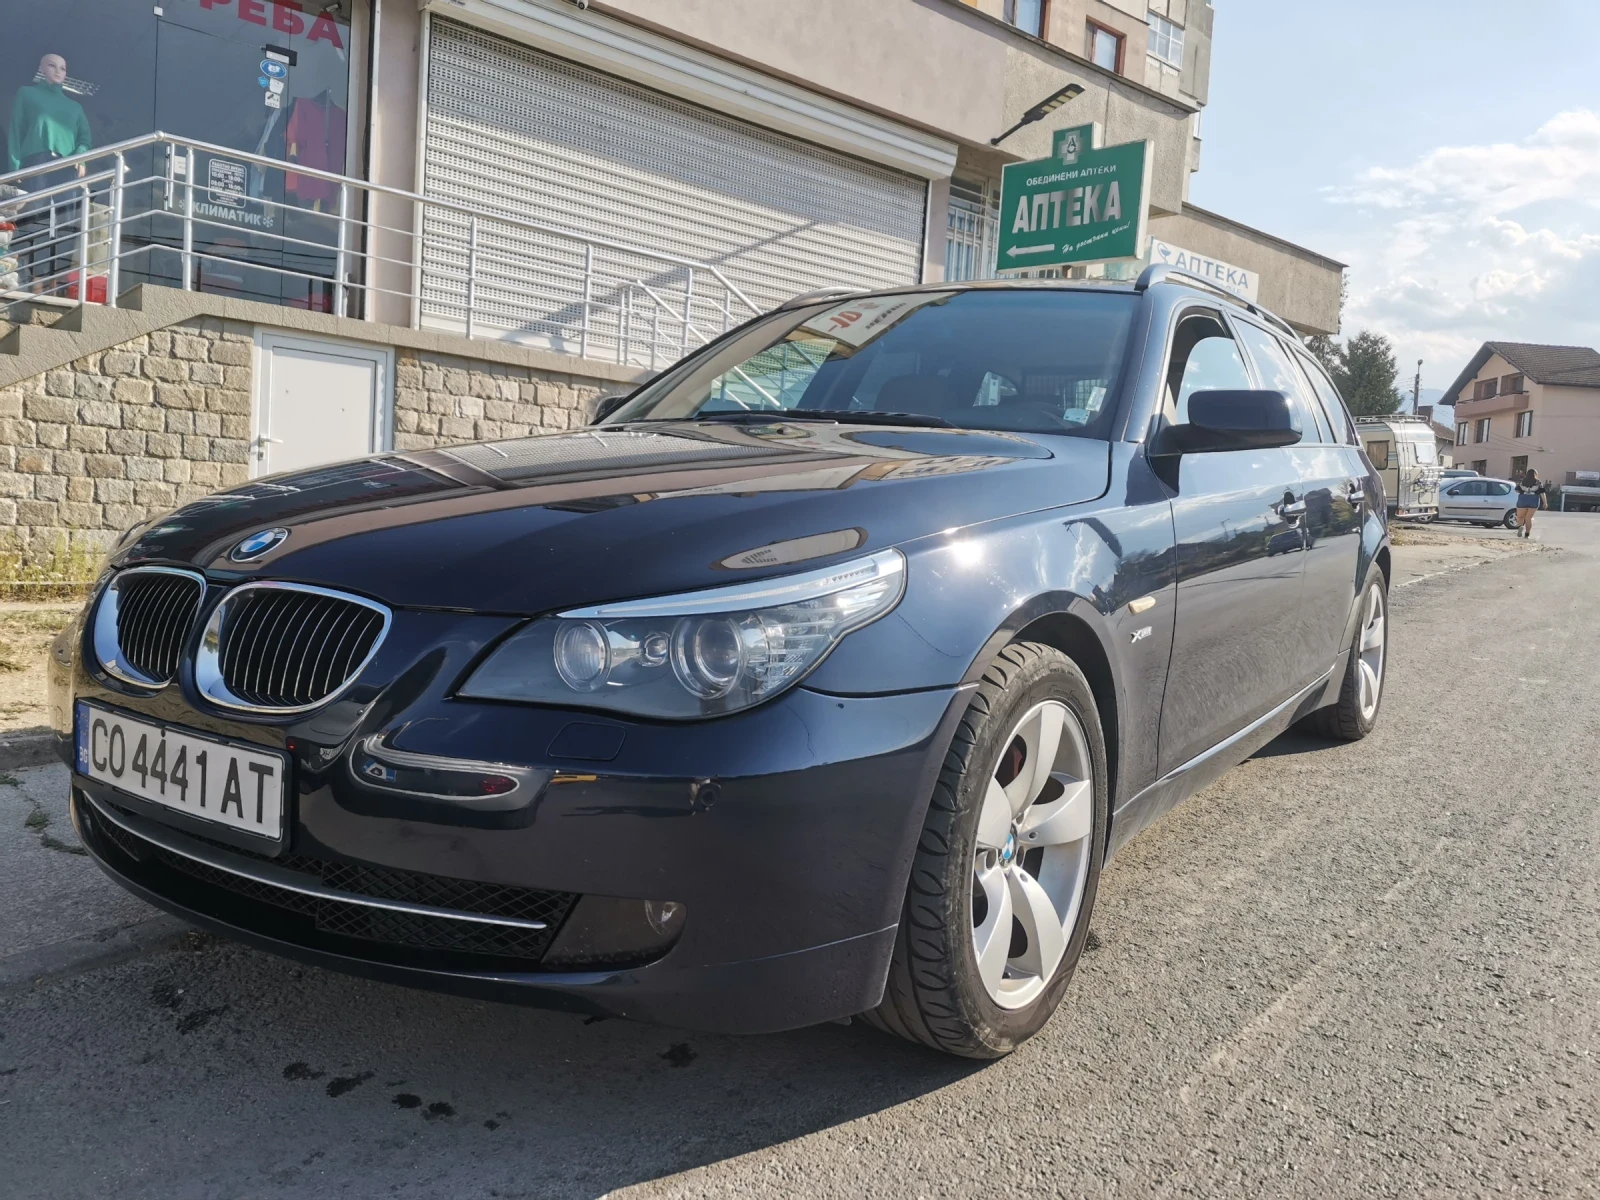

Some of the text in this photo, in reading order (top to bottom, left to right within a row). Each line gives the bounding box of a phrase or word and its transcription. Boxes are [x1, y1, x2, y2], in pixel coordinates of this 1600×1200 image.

[1026, 164, 1117, 187] ОБЕДИНЕНИ АПТЕКИ
[192, 202, 261, 226] КЛИМАТИК
[1012, 181, 1122, 234] АПТЕКА
[1175, 252, 1249, 289] АПТЕКА
[92, 718, 274, 824] CO 4441 AT
